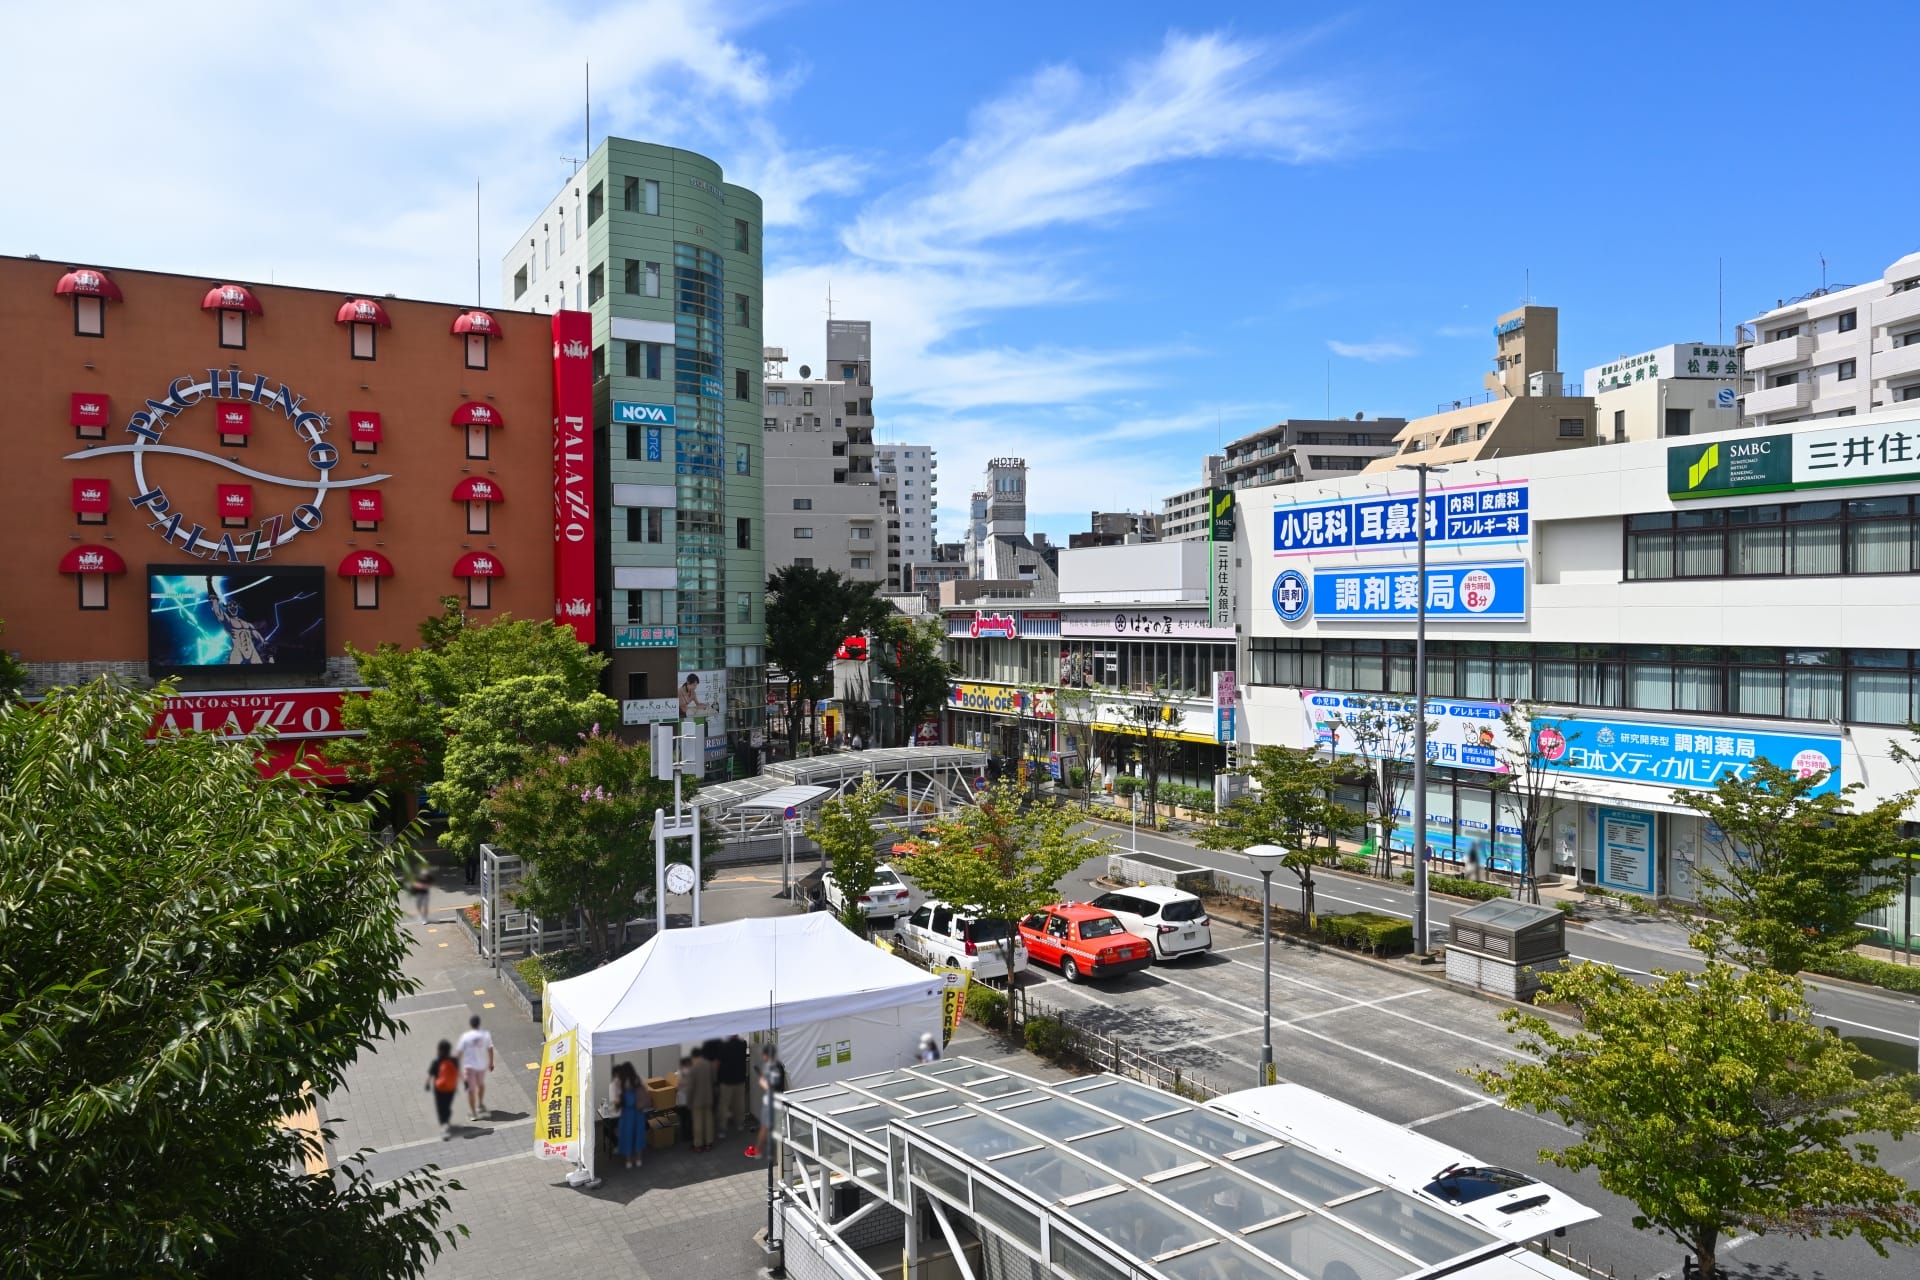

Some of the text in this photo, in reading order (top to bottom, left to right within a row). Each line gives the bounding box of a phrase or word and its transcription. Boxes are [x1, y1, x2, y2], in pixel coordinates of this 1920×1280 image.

[126, 368, 340, 470] PACHINCO
[622, 405, 667, 421] NOVA
[1730, 442, 1771, 458] SMBC
[1808, 431, 1920, 470] 三井住
[565, 415, 590, 542] PALAZZO
[1450, 491, 1519, 513] 内科 皮膚科
[129, 486, 322, 562] PALAZZO
[1280, 500, 1438, 547] 小児科 耳鼻科
[1451, 516, 1520, 536] アレルギー科
[1218, 545, 1229, 623] 三井住友銀行
[1281, 589, 1300, 601] 調剤
[1336, 575, 1455, 611] 調剤薬局
[1464, 582, 1491, 591] 待ち時間
[1467, 591, 1488, 607] 8分
[1453, 707, 1496, 719] アレルギー科
[1620, 732, 1756, 759] 研究開発型 調剤薬局
[1569, 747, 1770, 788] 日本メディカルシス
